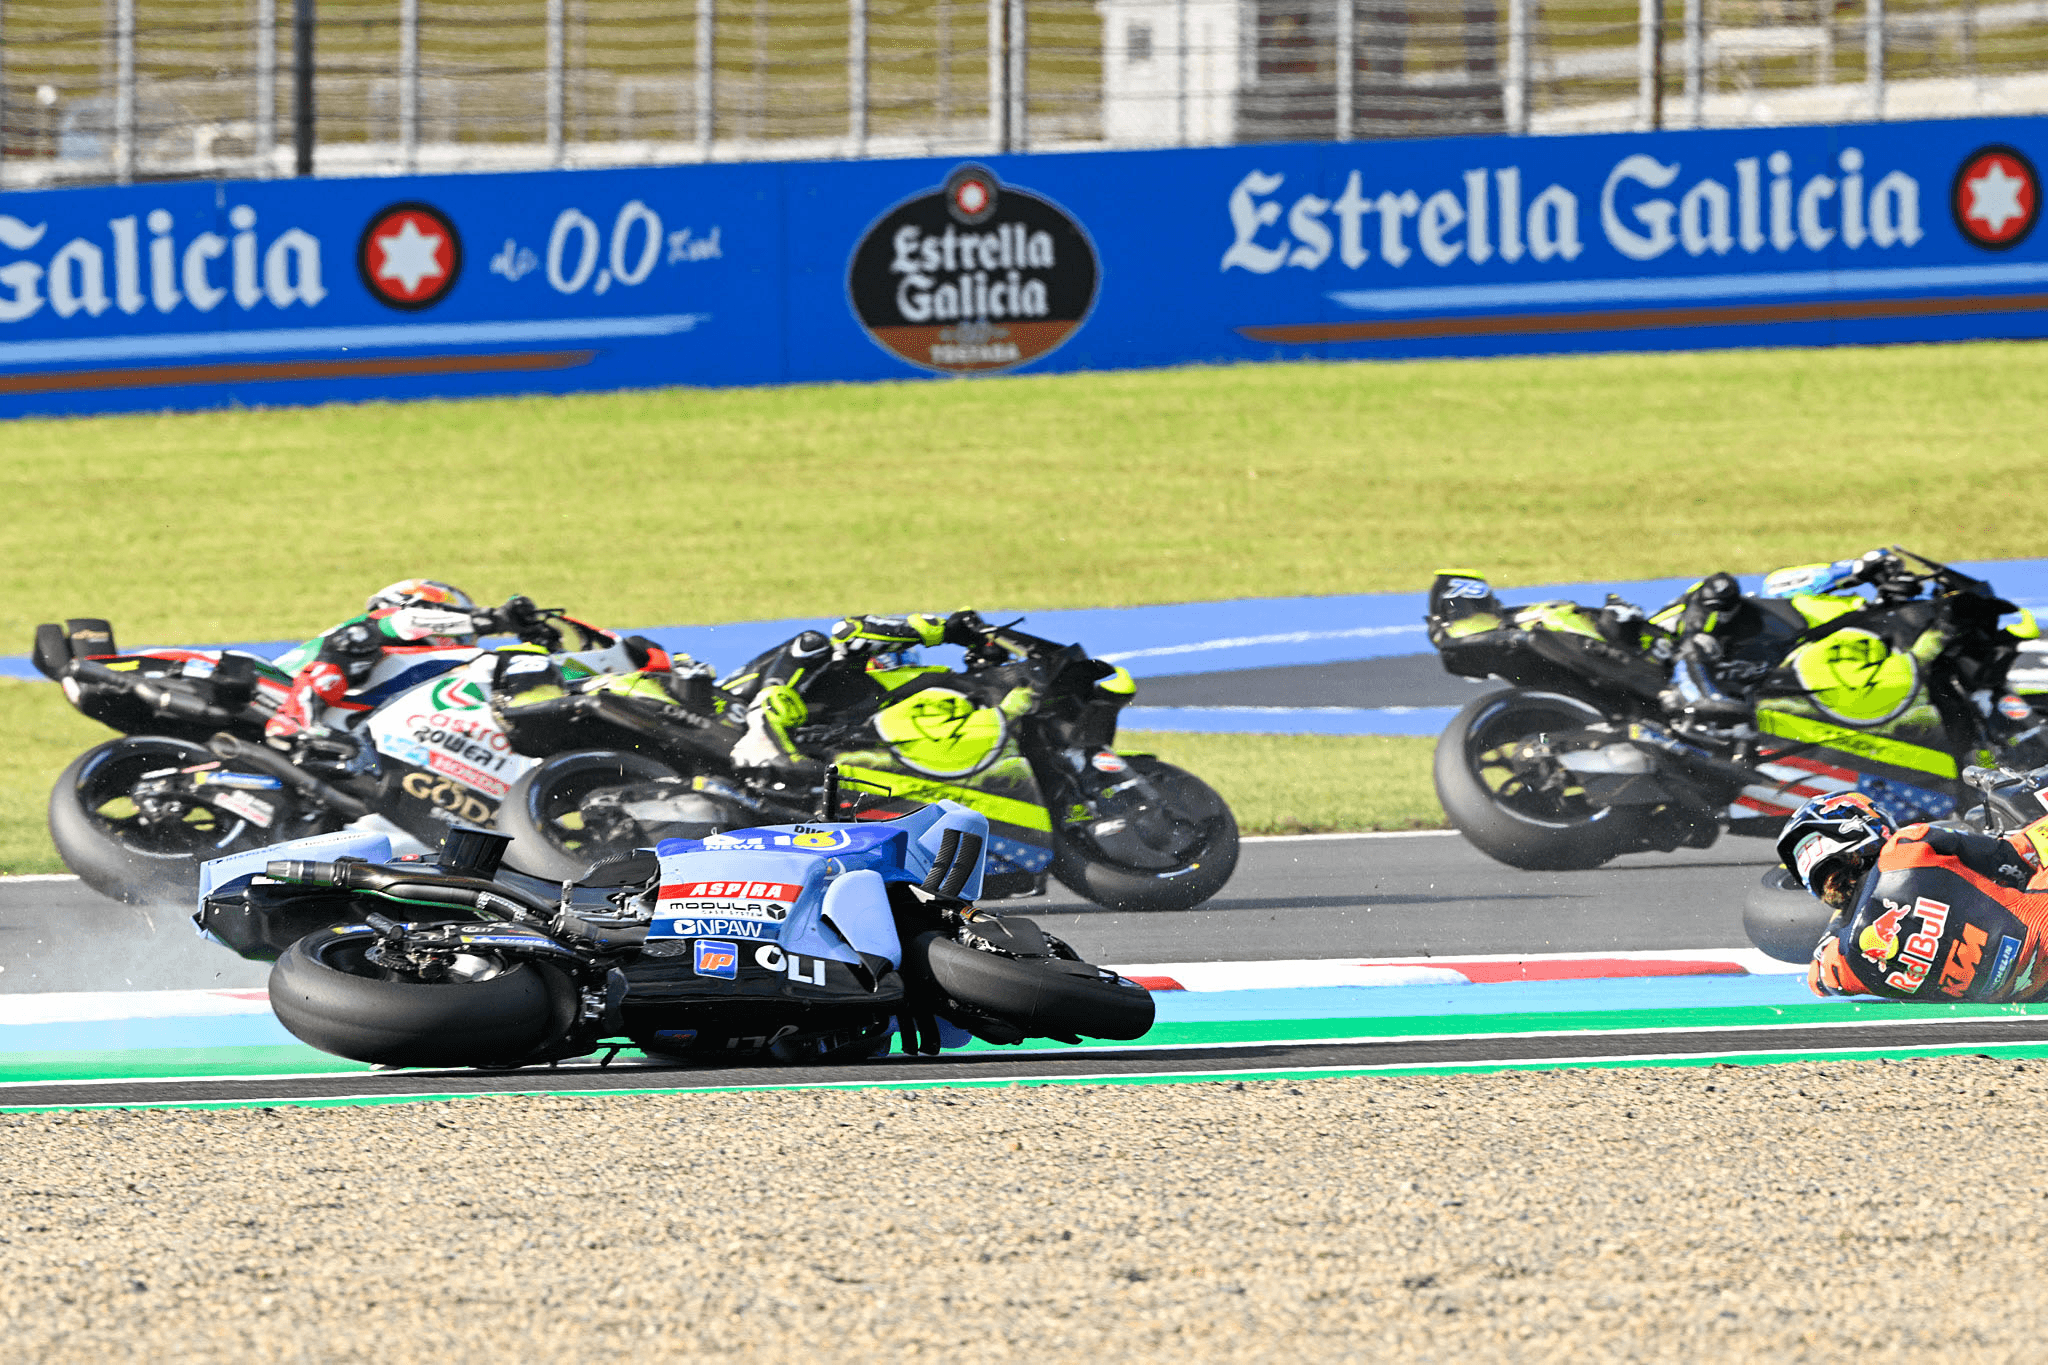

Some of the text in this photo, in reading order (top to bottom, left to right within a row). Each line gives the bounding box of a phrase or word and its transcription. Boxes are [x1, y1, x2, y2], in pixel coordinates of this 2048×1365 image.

[1221, 146, 1925, 273] Estrella Galicia
[891, 222, 1056, 274] Estrella
[897, 269, 1051, 323] Galicia
[406, 713, 513, 755] Castro
[670, 902, 762, 912] MODULA
[689, 881, 783, 899] ASPIRA
[696, 919, 763, 938] NPAW
[1884, 896, 1951, 994] Red Bull
[699, 952, 735, 971] IP
[754, 944, 826, 986] OLI
[1938, 922, 1989, 998] KTM
